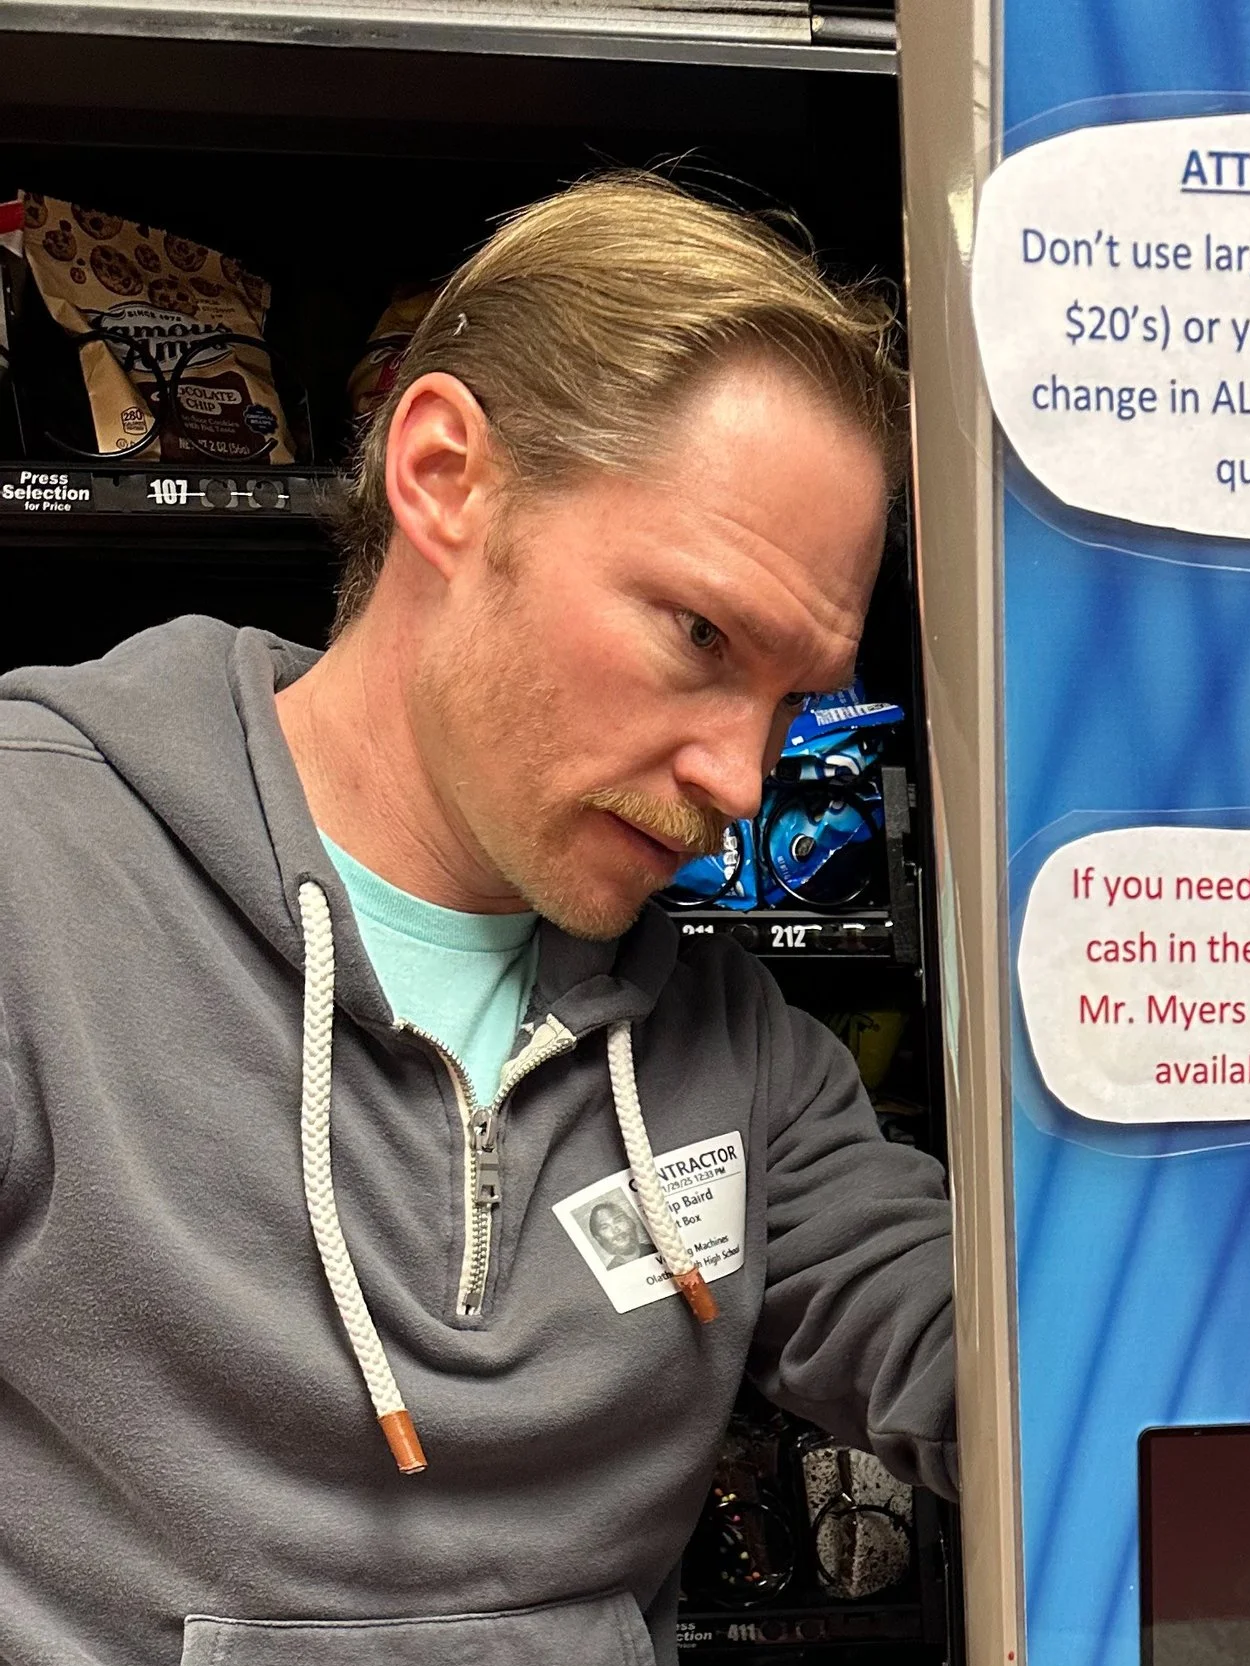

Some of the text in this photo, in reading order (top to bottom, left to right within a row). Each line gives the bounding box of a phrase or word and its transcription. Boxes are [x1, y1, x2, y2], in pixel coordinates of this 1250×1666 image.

[1133, 242, 1192, 270] use
[104, 321, 232, 343] amous
[1184, 317, 1220, 344] or
[180, 386, 237, 402] COLATE
[186, 398, 216, 411] CHIP
[1032, 374, 1157, 421] change
[1170, 379, 1199, 414] in
[124, 409, 143, 421] 280
[20, 471, 69, 485] Press
[1, 484, 90, 501] Selection
[150, 479, 188, 505] 107
[24, 501, 72, 512] for Price
[1073, 866, 1095, 899] If
[1103, 876, 1163, 907] you
[771, 924, 806, 948] 212
[1086, 931, 1157, 963] cash
[1169, 932, 1196, 963] in
[1080, 994, 1134, 1024] Mr.
[1147, 994, 1246, 1031] Myers
[628, 1145, 738, 1193] CNTRACTOR
[714, 1166, 726, 1176] PM
[681, 1187, 714, 1208] Baird
[682, 1214, 702, 1226] Box
[694, 1235, 729, 1253] Machines
[646, 1270, 674, 1286] Olath
[703, 1253, 721, 1267] High
[676, 1630, 713, 1642] ction
[727, 1623, 756, 1642] 411
